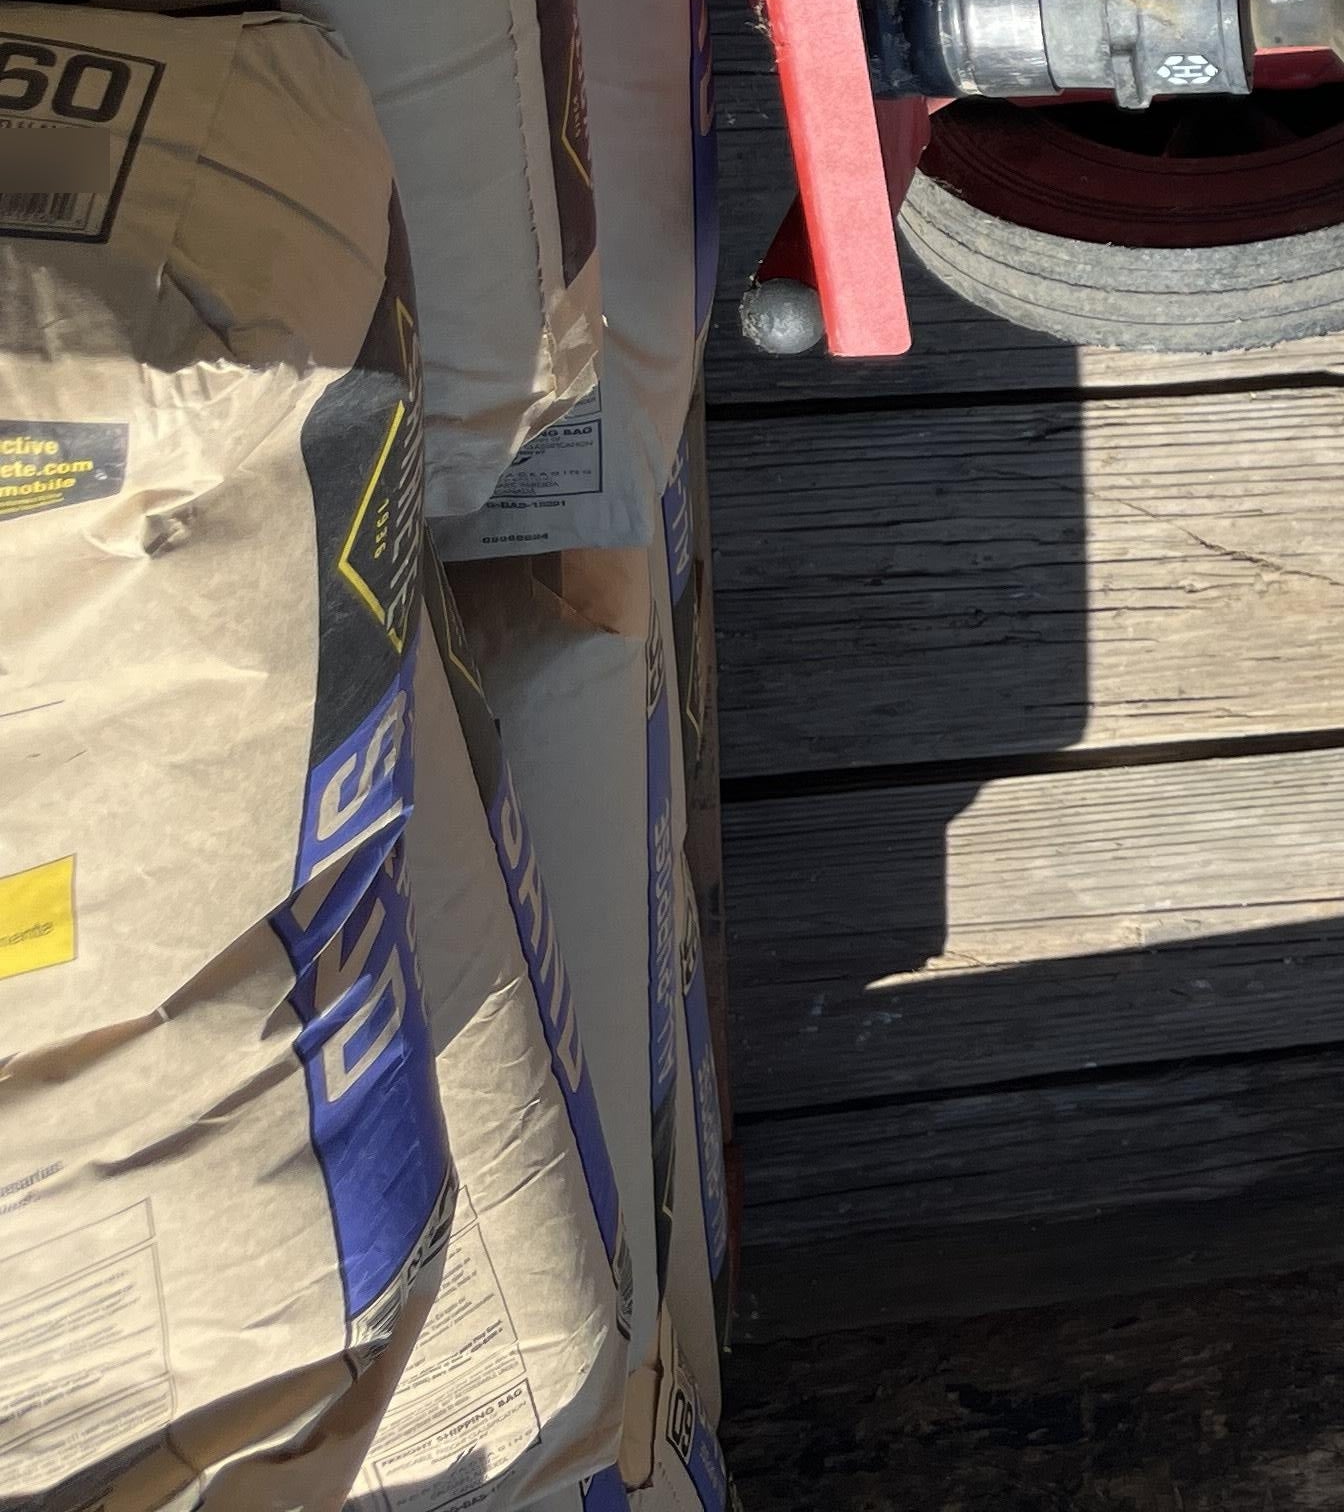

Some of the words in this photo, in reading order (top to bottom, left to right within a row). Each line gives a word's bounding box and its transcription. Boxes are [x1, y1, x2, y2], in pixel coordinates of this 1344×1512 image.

[0, 41, 132, 123] 60
[373, 497, 390, 560] 1936
[671, 1388, 693, 1457] 60
